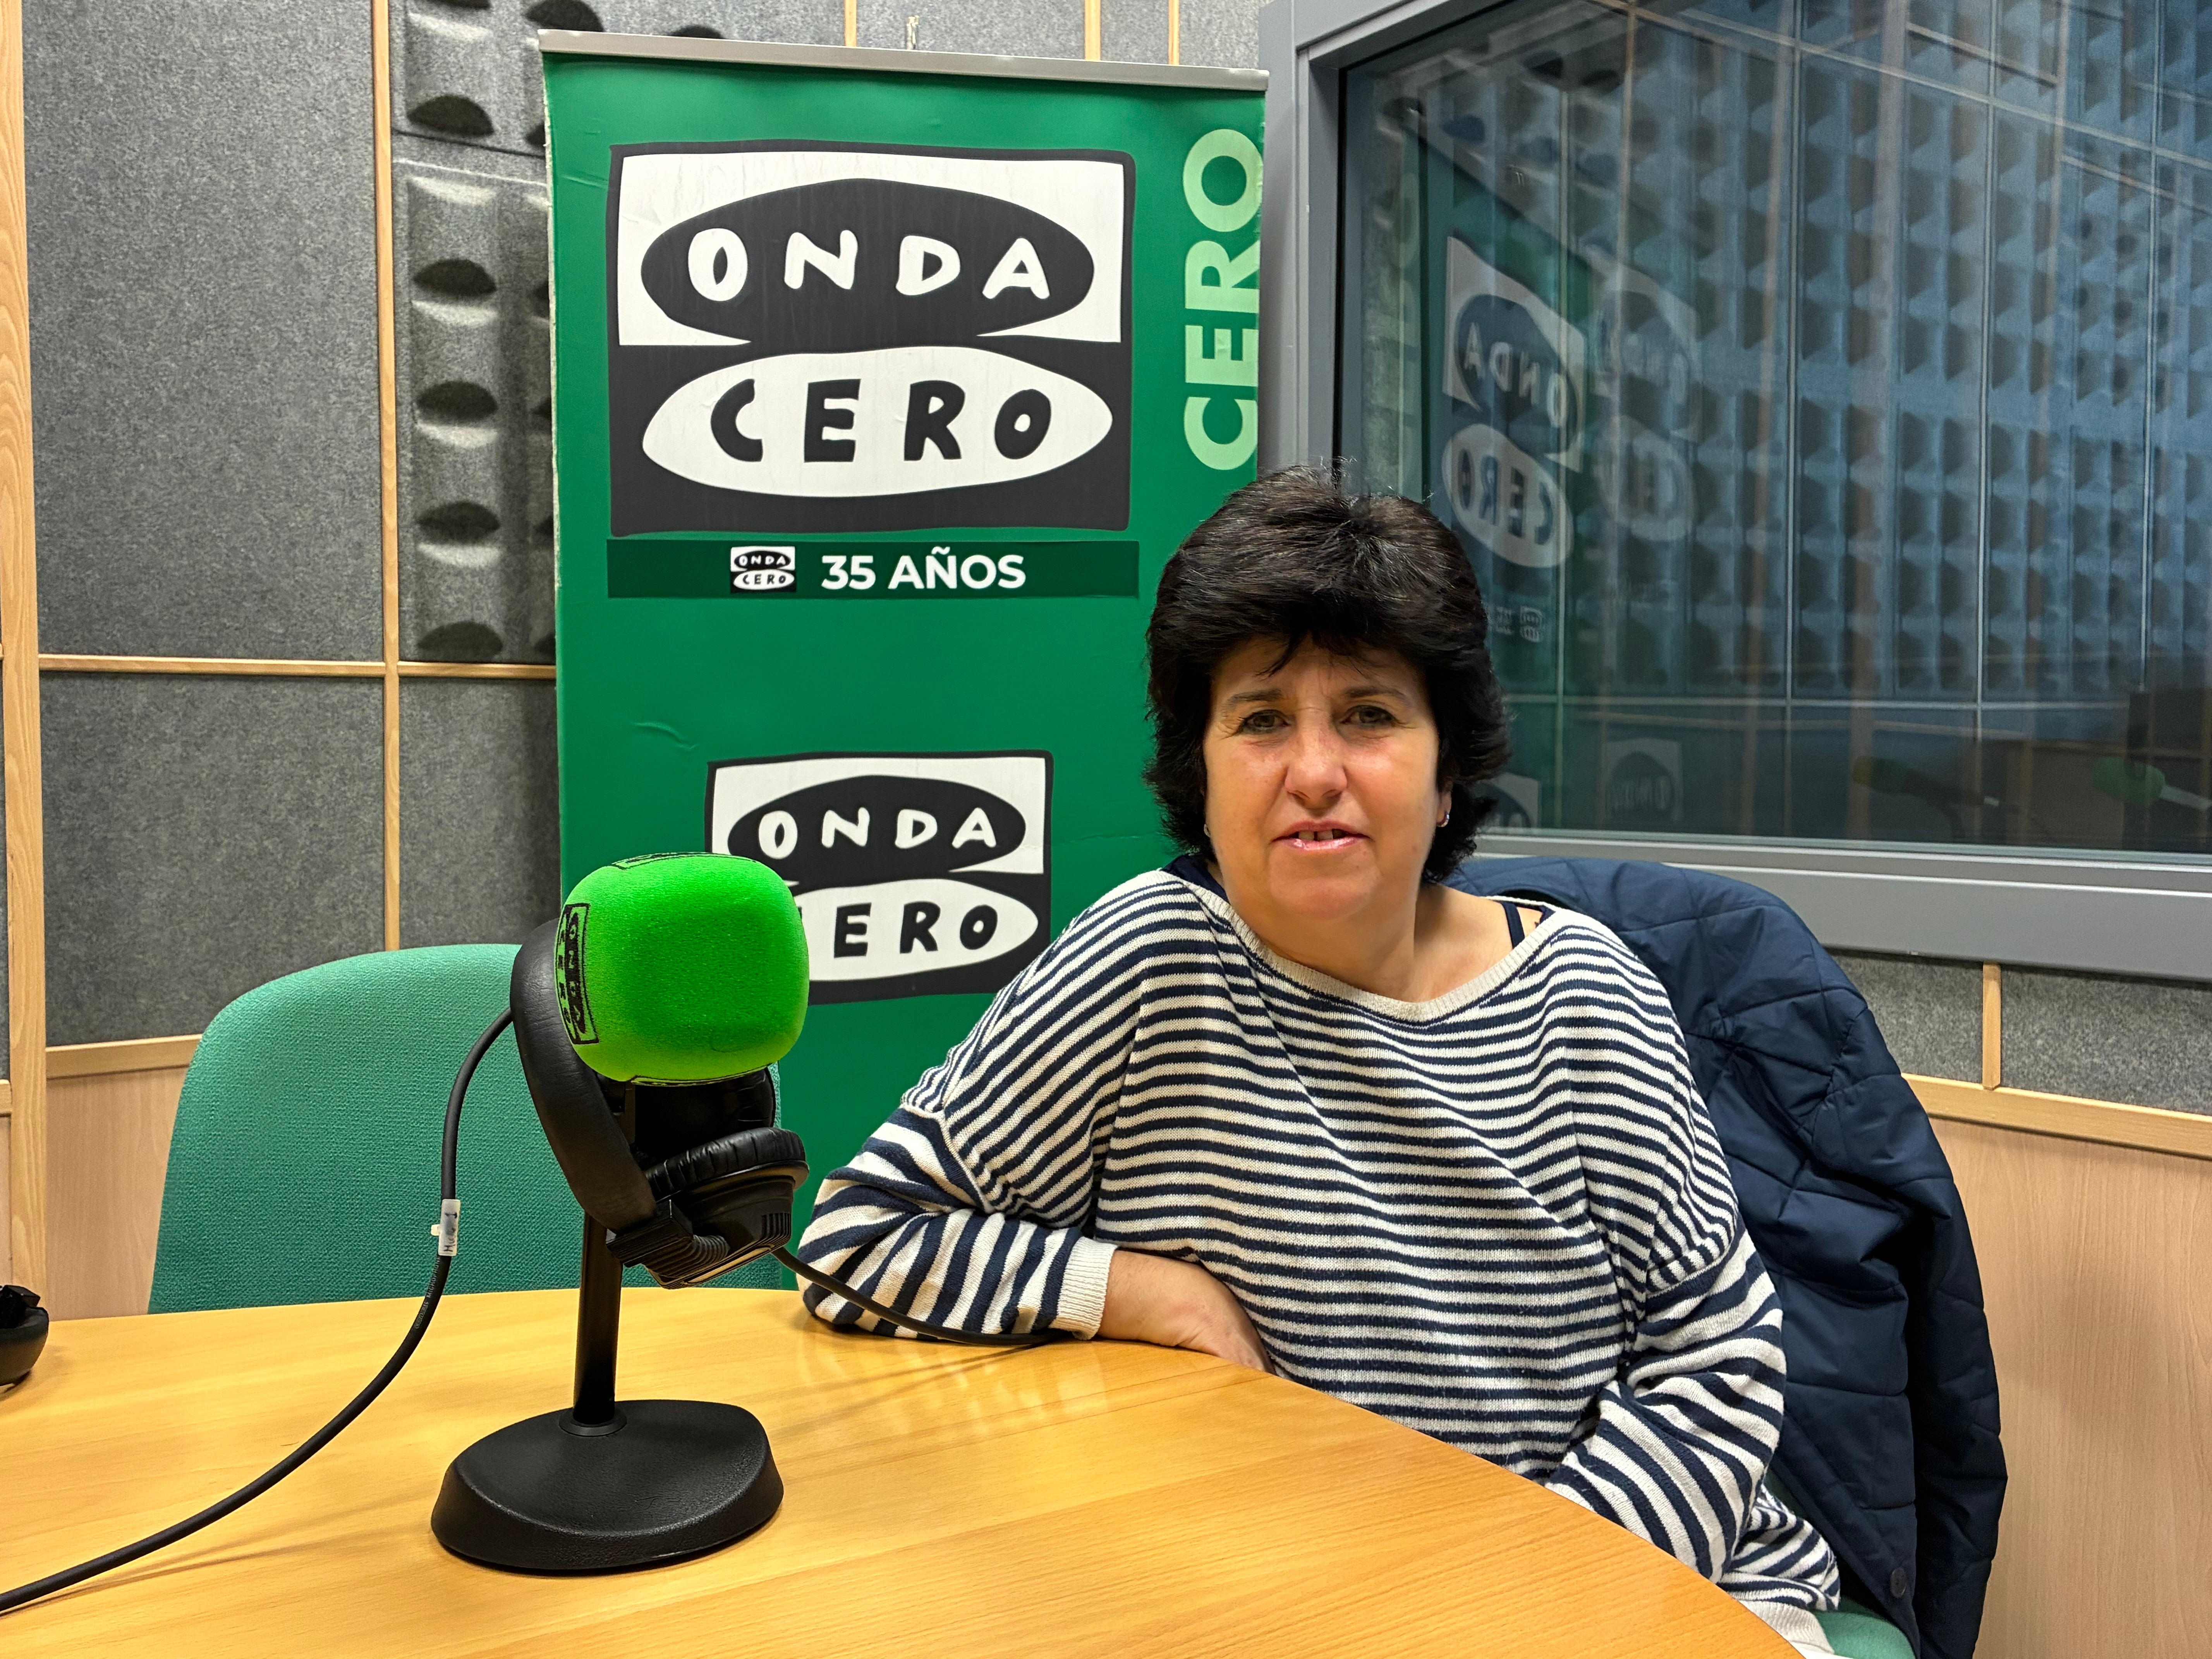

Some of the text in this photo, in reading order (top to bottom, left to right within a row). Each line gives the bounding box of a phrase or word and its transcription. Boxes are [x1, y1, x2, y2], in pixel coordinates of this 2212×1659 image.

[688, 227, 1050, 301] ONDA
[1183, 129, 1263, 470] CERO
[711, 378, 1051, 464] CERO
[739, 555, 786, 566] ONDA
[743, 574, 786, 585] CERO
[821, 546, 1026, 590] 35 AÑOS
[758, 807, 996, 859] ONDA
[798, 901, 998, 958] ERO
